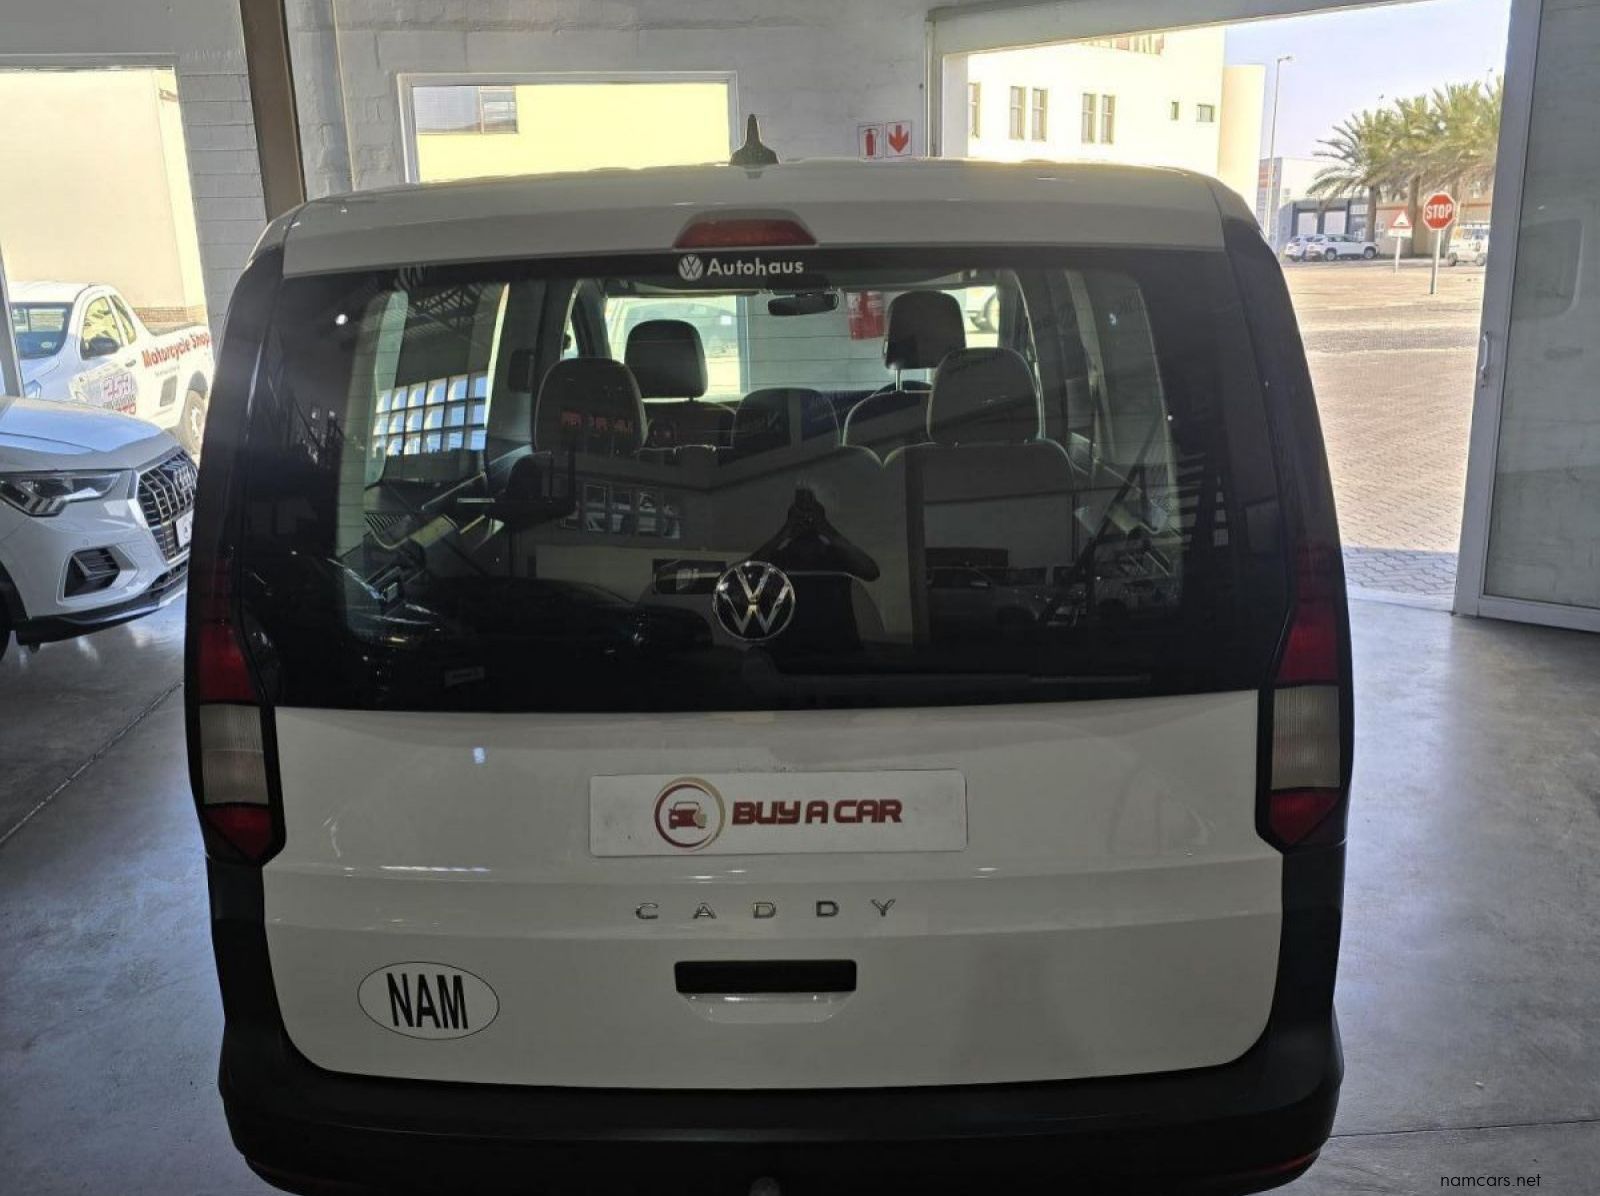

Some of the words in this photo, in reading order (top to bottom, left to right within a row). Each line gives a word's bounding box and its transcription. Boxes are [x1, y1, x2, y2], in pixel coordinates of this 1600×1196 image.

[1426, 203, 1453, 220] STOP
[707, 257, 804, 277] Autohaus
[142, 338, 190, 369] Motorcycle
[731, 800, 801, 825] BUY
[805, 800, 829, 824] A
[833, 799, 903, 824] CAR
[635, 899, 896, 920] CADDY
[386, 972, 468, 1029] NAM
